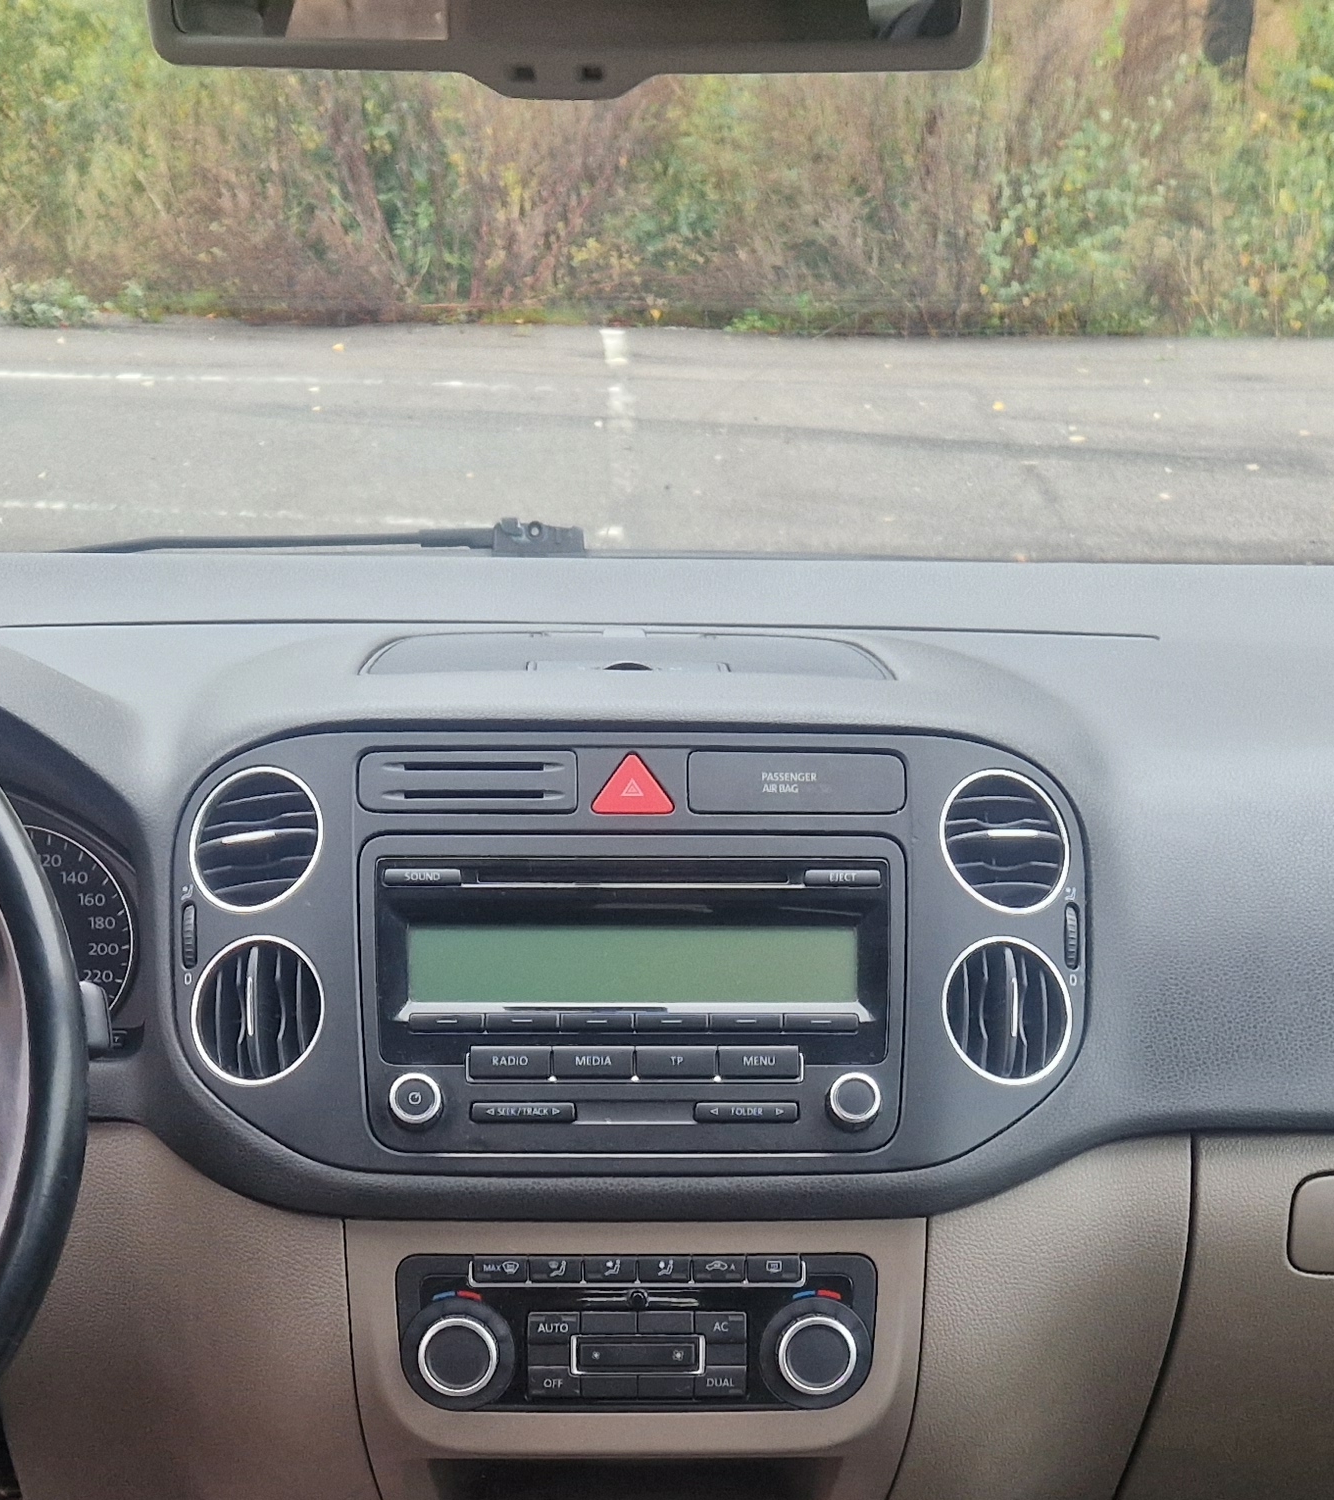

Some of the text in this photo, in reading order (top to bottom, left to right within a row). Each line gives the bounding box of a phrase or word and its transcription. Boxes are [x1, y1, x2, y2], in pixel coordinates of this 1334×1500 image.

[761, 772, 817, 782] PASSENGER
[60, 871, 88, 884] 140
[404, 872, 441, 881] SOUND
[829, 873, 857, 882] EJECT
[78, 893, 105, 906] 160
[88, 916, 116, 929] 180
[88, 943, 119, 955] 200
[83, 970, 114, 982] 220
[492, 1056, 528, 1066] RADIO
[575, 1056, 612, 1066] MEDIA
[670, 1056, 684, 1066] TP
[743, 1056, 776, 1066] MENU
[731, 1107, 763, 1116] FOLDER
[483, 1264, 502, 1272] MAX
[537, 1323, 569, 1333] AUTO
[713, 1322, 729, 1332] AC
[543, 1378, 564, 1388] OFF
[706, 1378, 735, 1387] DUAL
